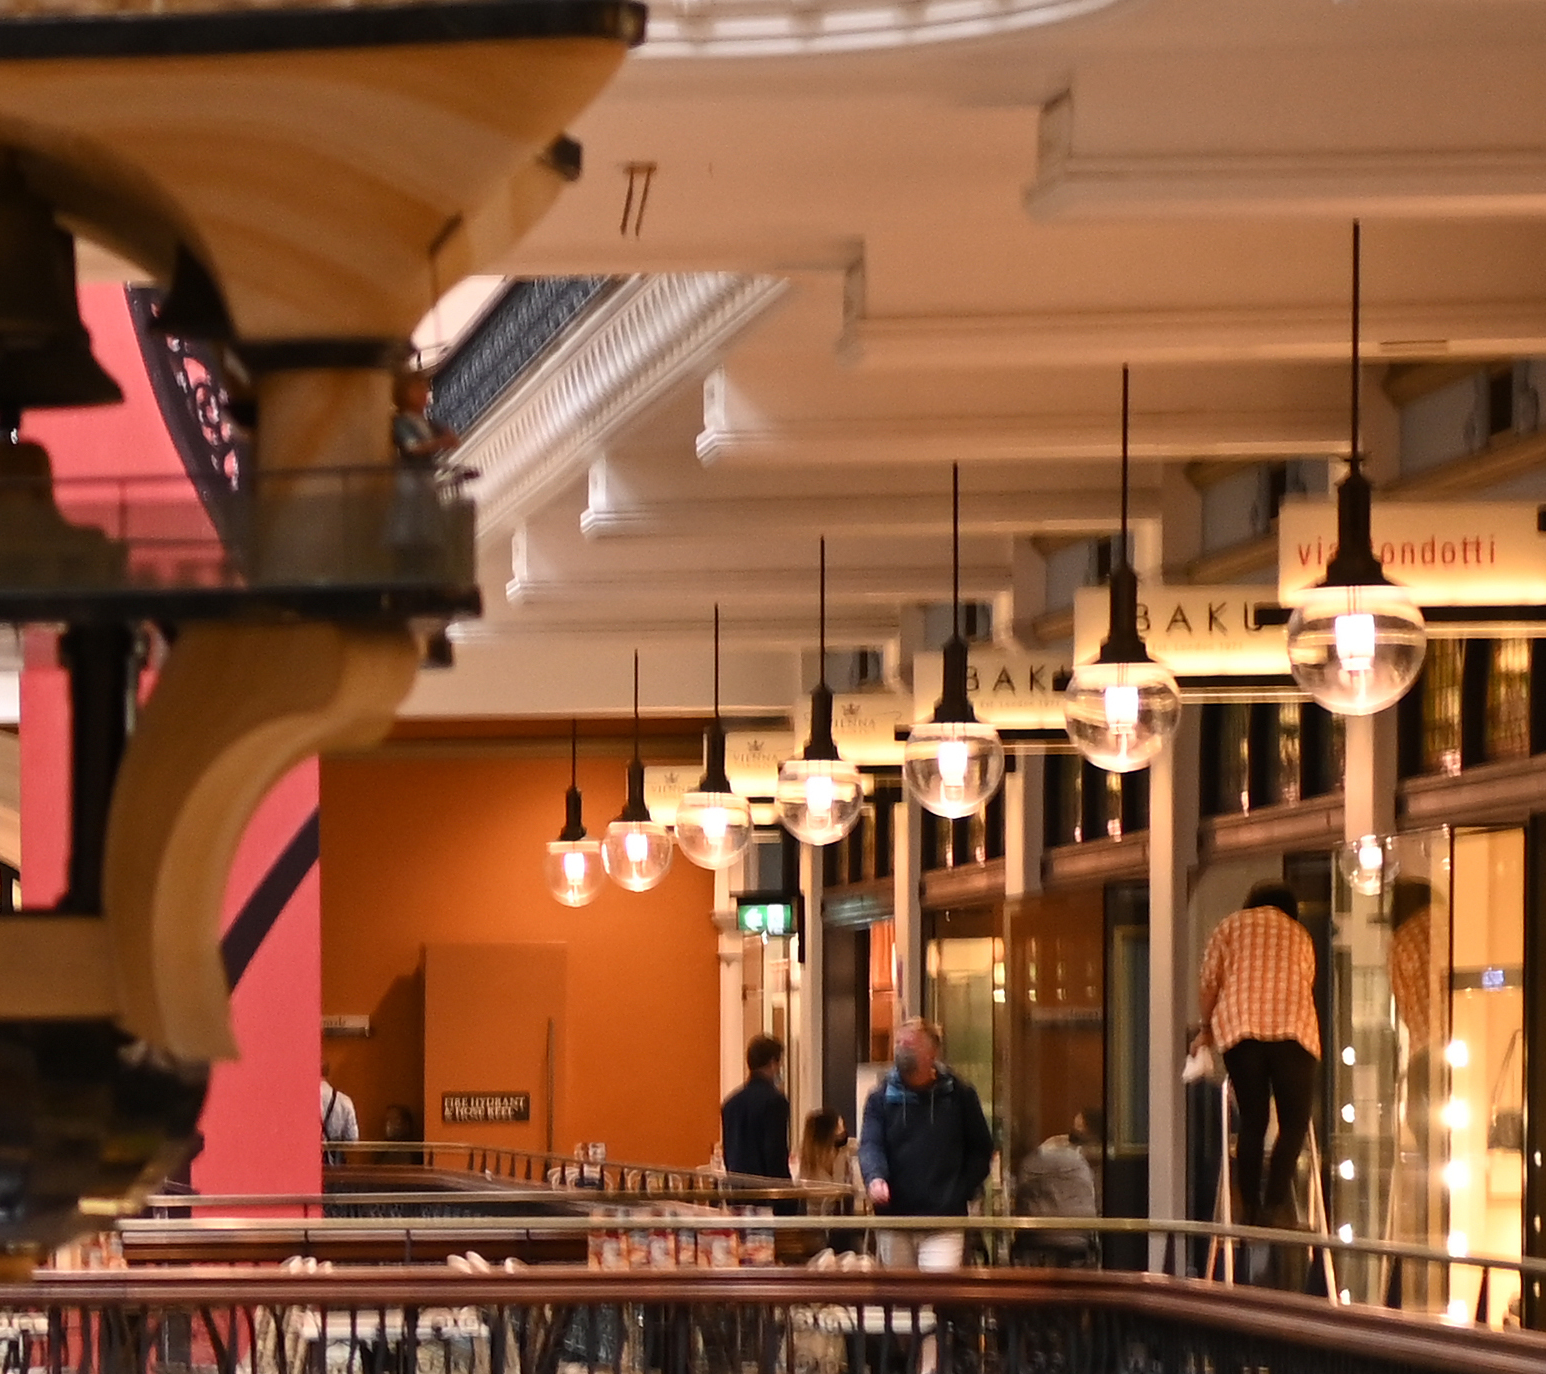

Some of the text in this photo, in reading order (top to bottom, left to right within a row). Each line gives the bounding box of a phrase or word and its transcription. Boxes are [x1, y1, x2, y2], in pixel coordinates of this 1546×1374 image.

[1371, 534, 1497, 566] ondotti
[1136, 602, 1265, 633] BAKU
[966, 664, 1068, 693] BAK
[444, 1096, 525, 1110] FIRE HYDRANT
[455, 1106, 485, 1118] HOSE
